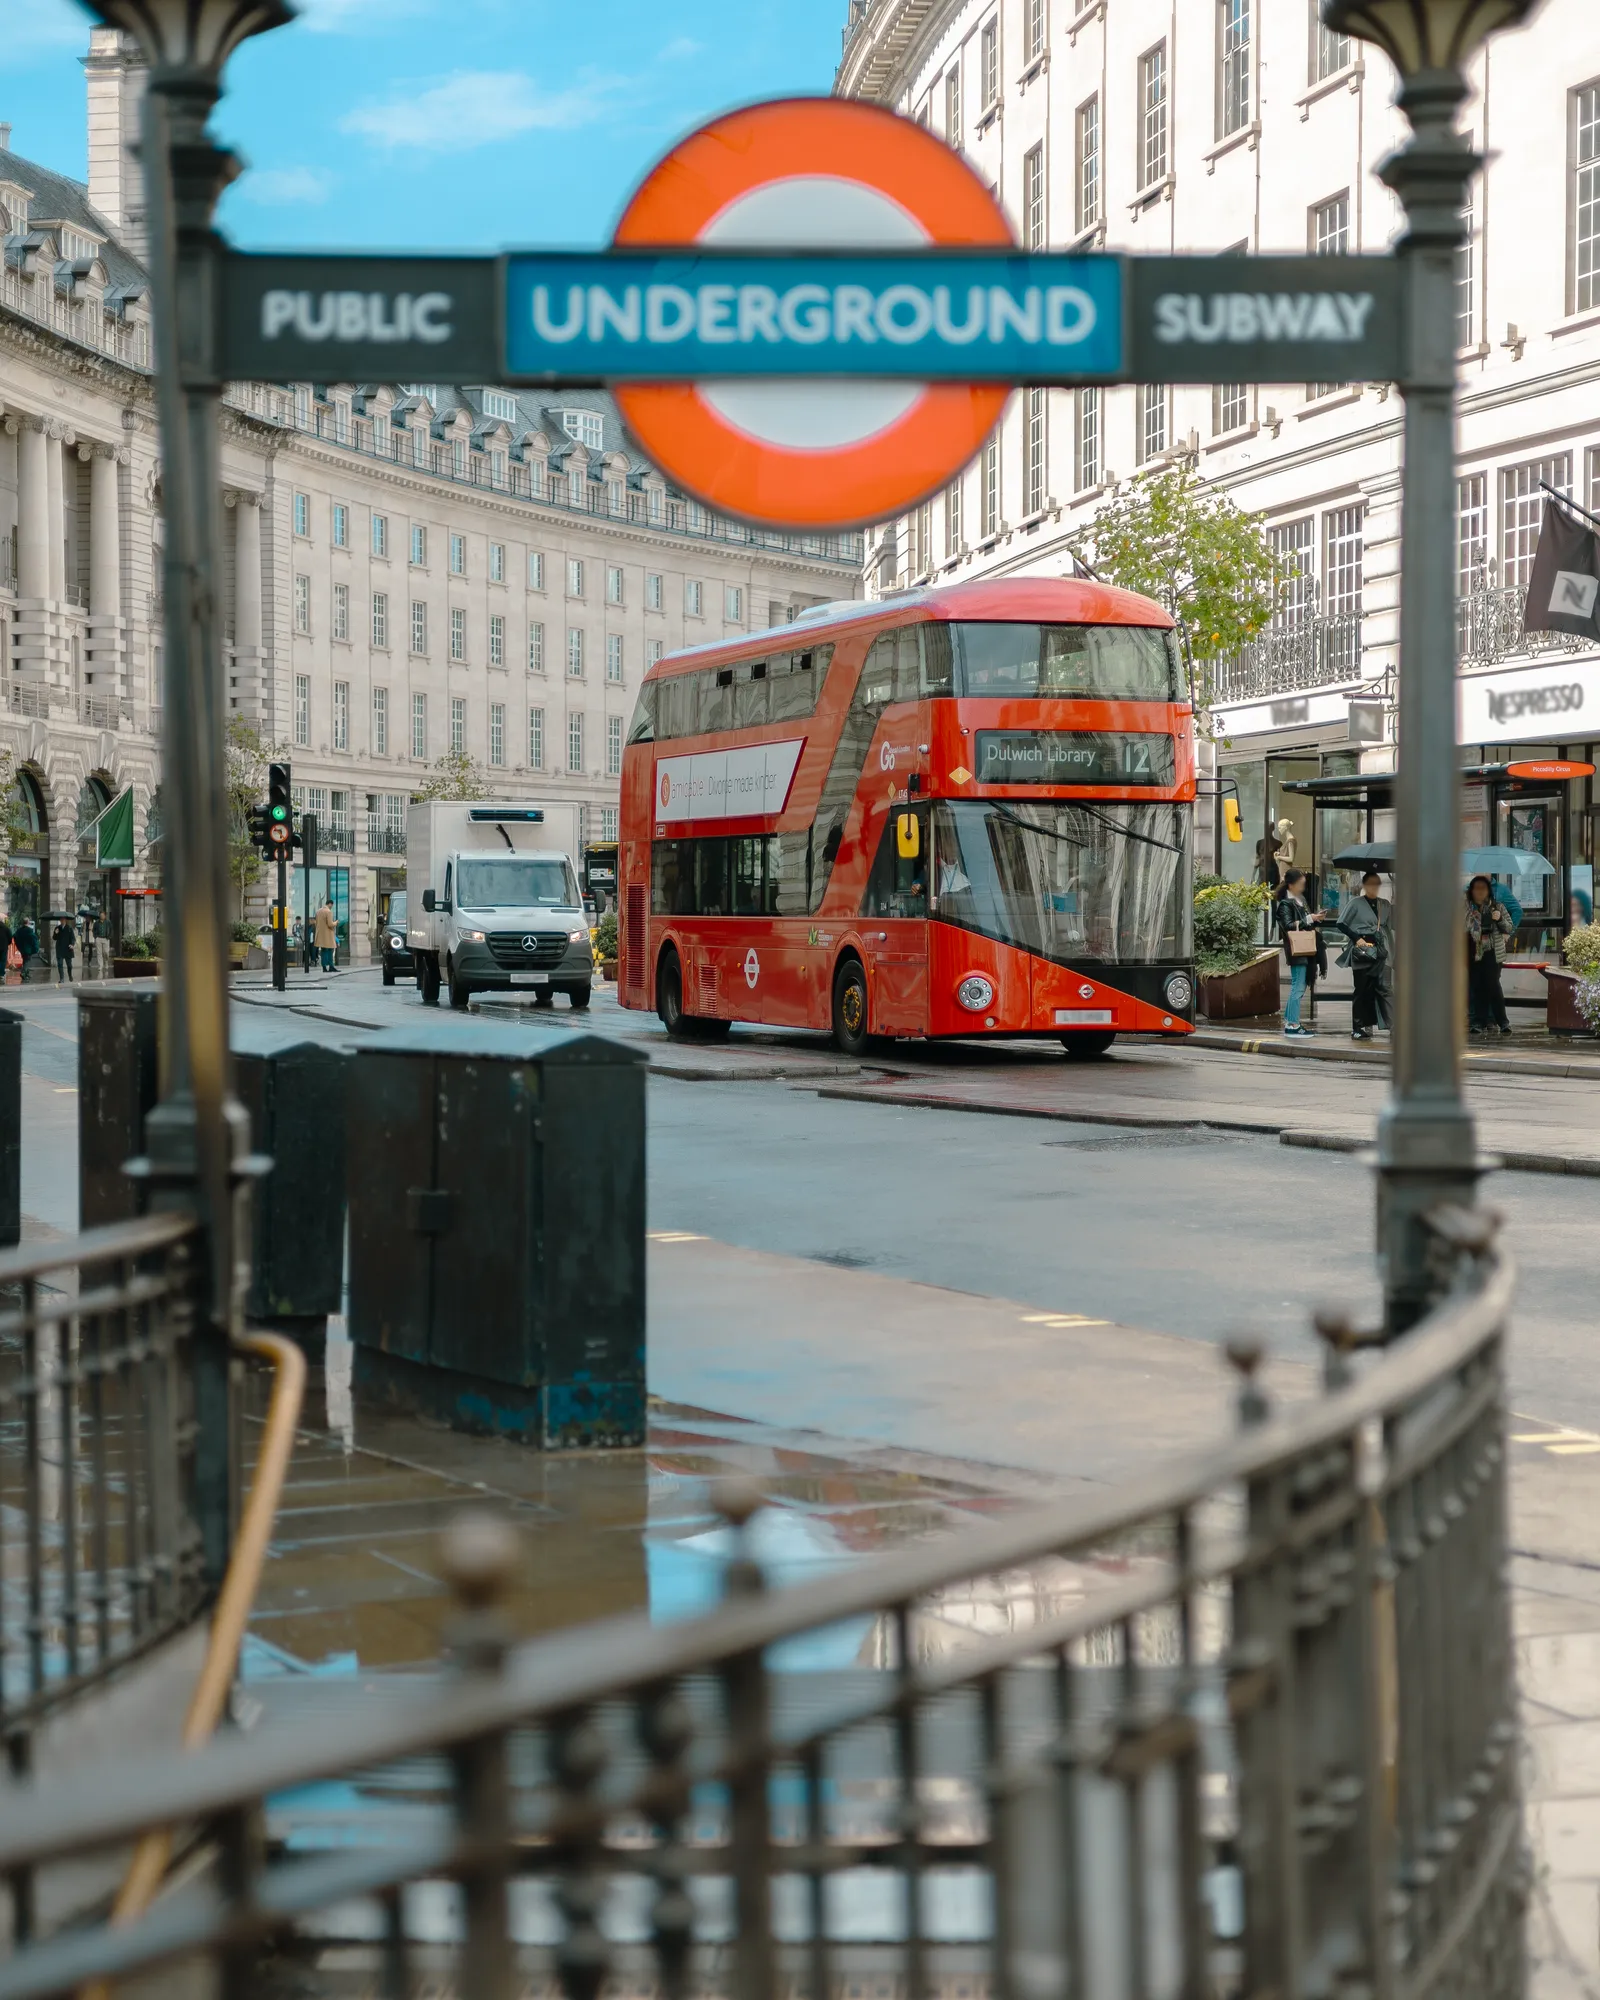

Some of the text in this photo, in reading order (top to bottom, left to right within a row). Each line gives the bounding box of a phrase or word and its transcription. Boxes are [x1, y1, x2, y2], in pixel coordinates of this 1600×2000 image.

[261, 289, 454, 344] PUBLIC
[531, 283, 1096, 345] UNDERGROUND
[1153, 290, 1373, 344] SUBWAY
[1485, 683, 1584, 725] NESPRESSO
[986, 744, 1096, 767] Dulwich Library
[1124, 743, 1150, 773] 12
[1532, 765, 1571, 774] Piccadilly Circus
[734, 771, 753, 794] made
[590, 868, 614, 879] SRL
